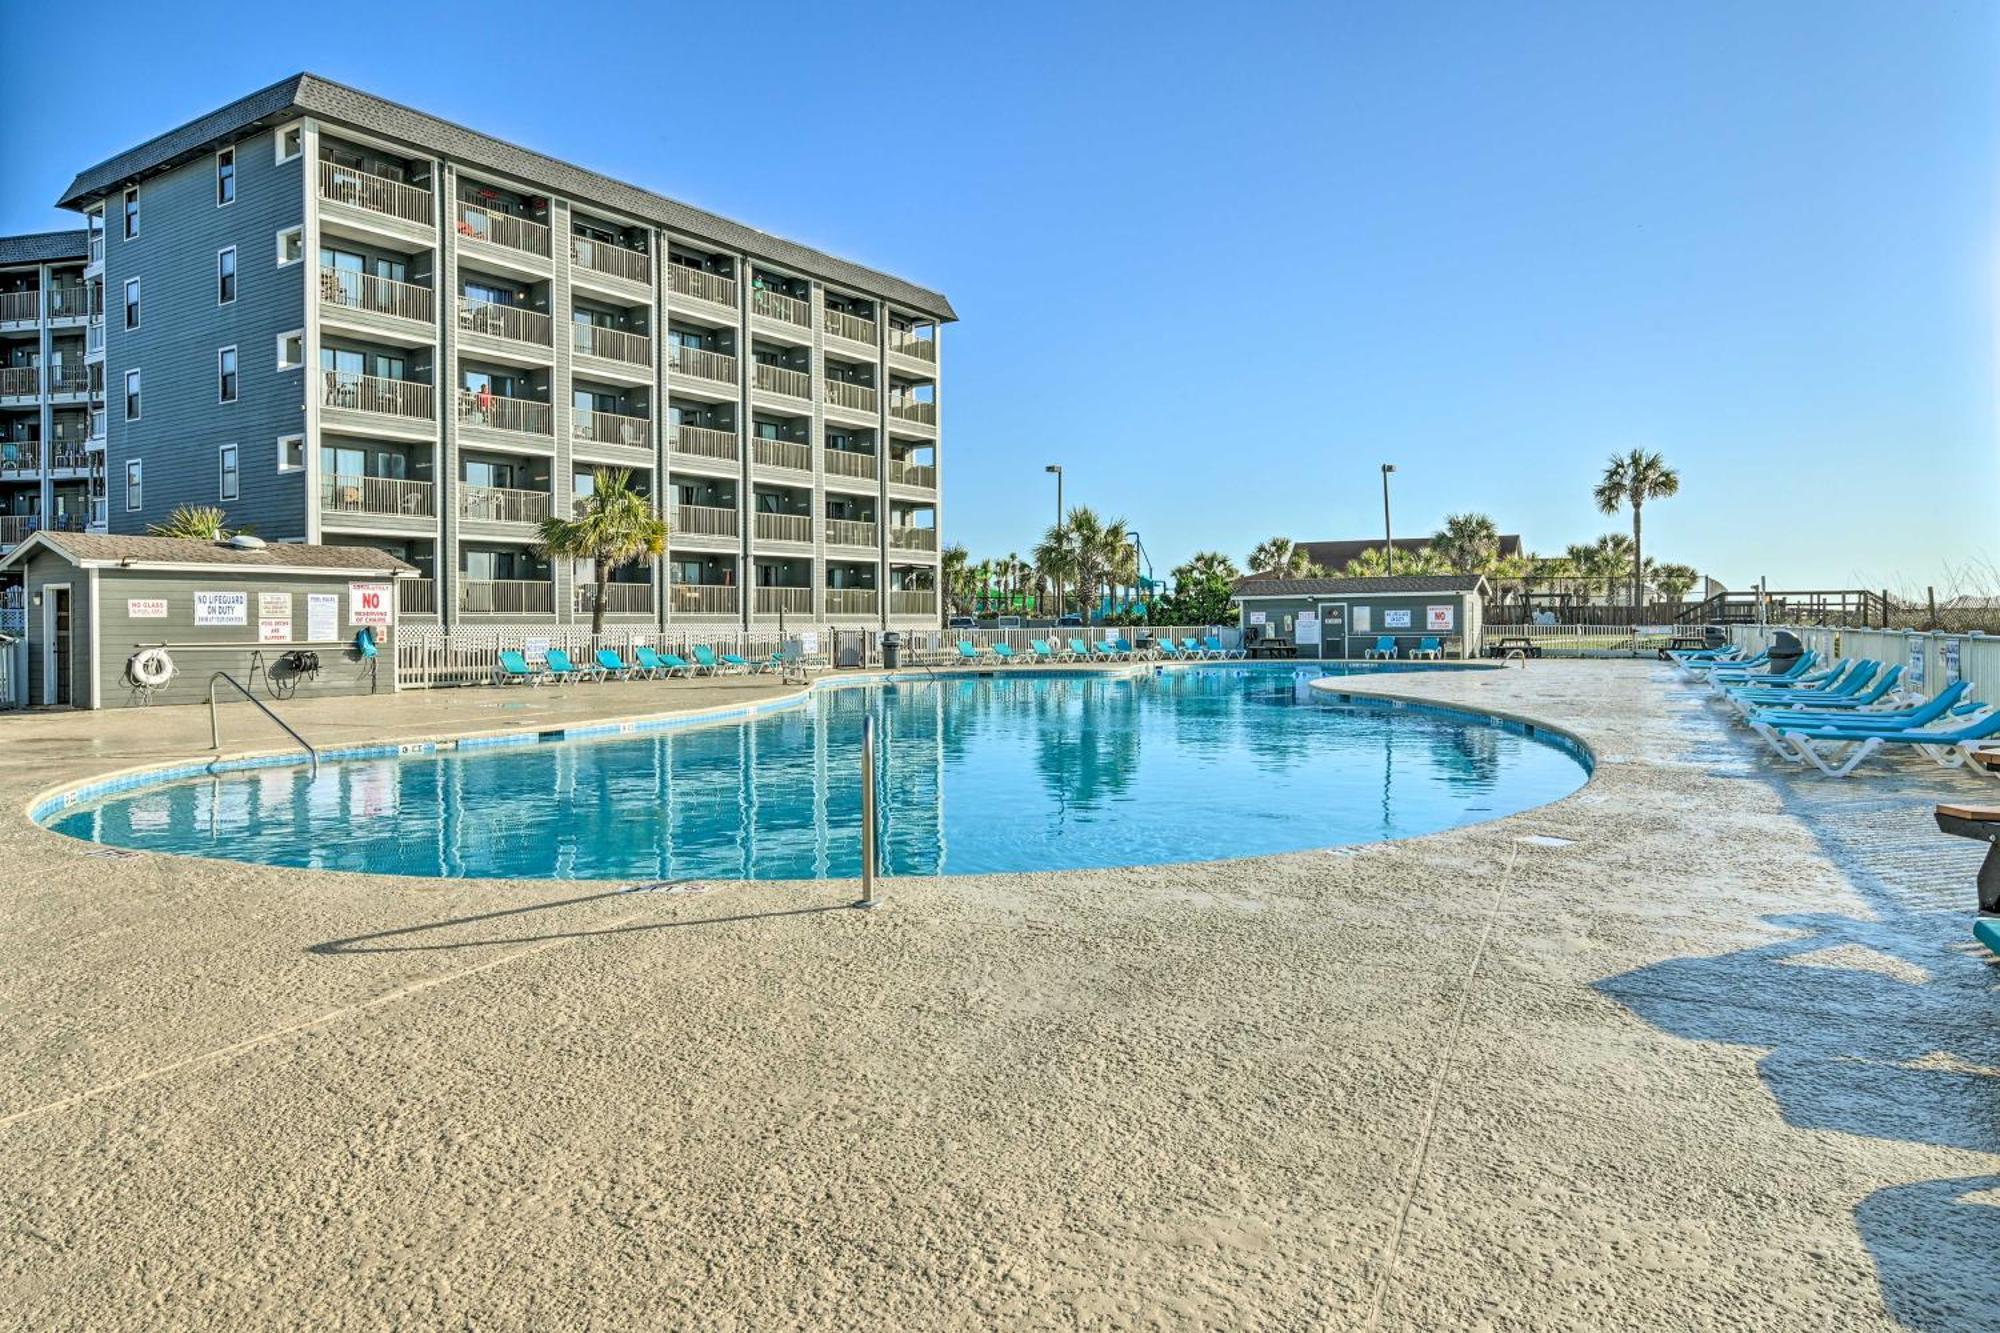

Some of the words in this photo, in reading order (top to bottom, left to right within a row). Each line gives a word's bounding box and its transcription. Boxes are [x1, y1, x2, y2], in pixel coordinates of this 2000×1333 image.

[198, 595, 207, 604] NO
[209, 595, 244, 604] LIFEGUARD
[363, 593, 379, 608] NO
[208, 605, 217, 615] ON
[218, 605, 235, 615] DUTY
[1434, 612, 1446, 621] NO
